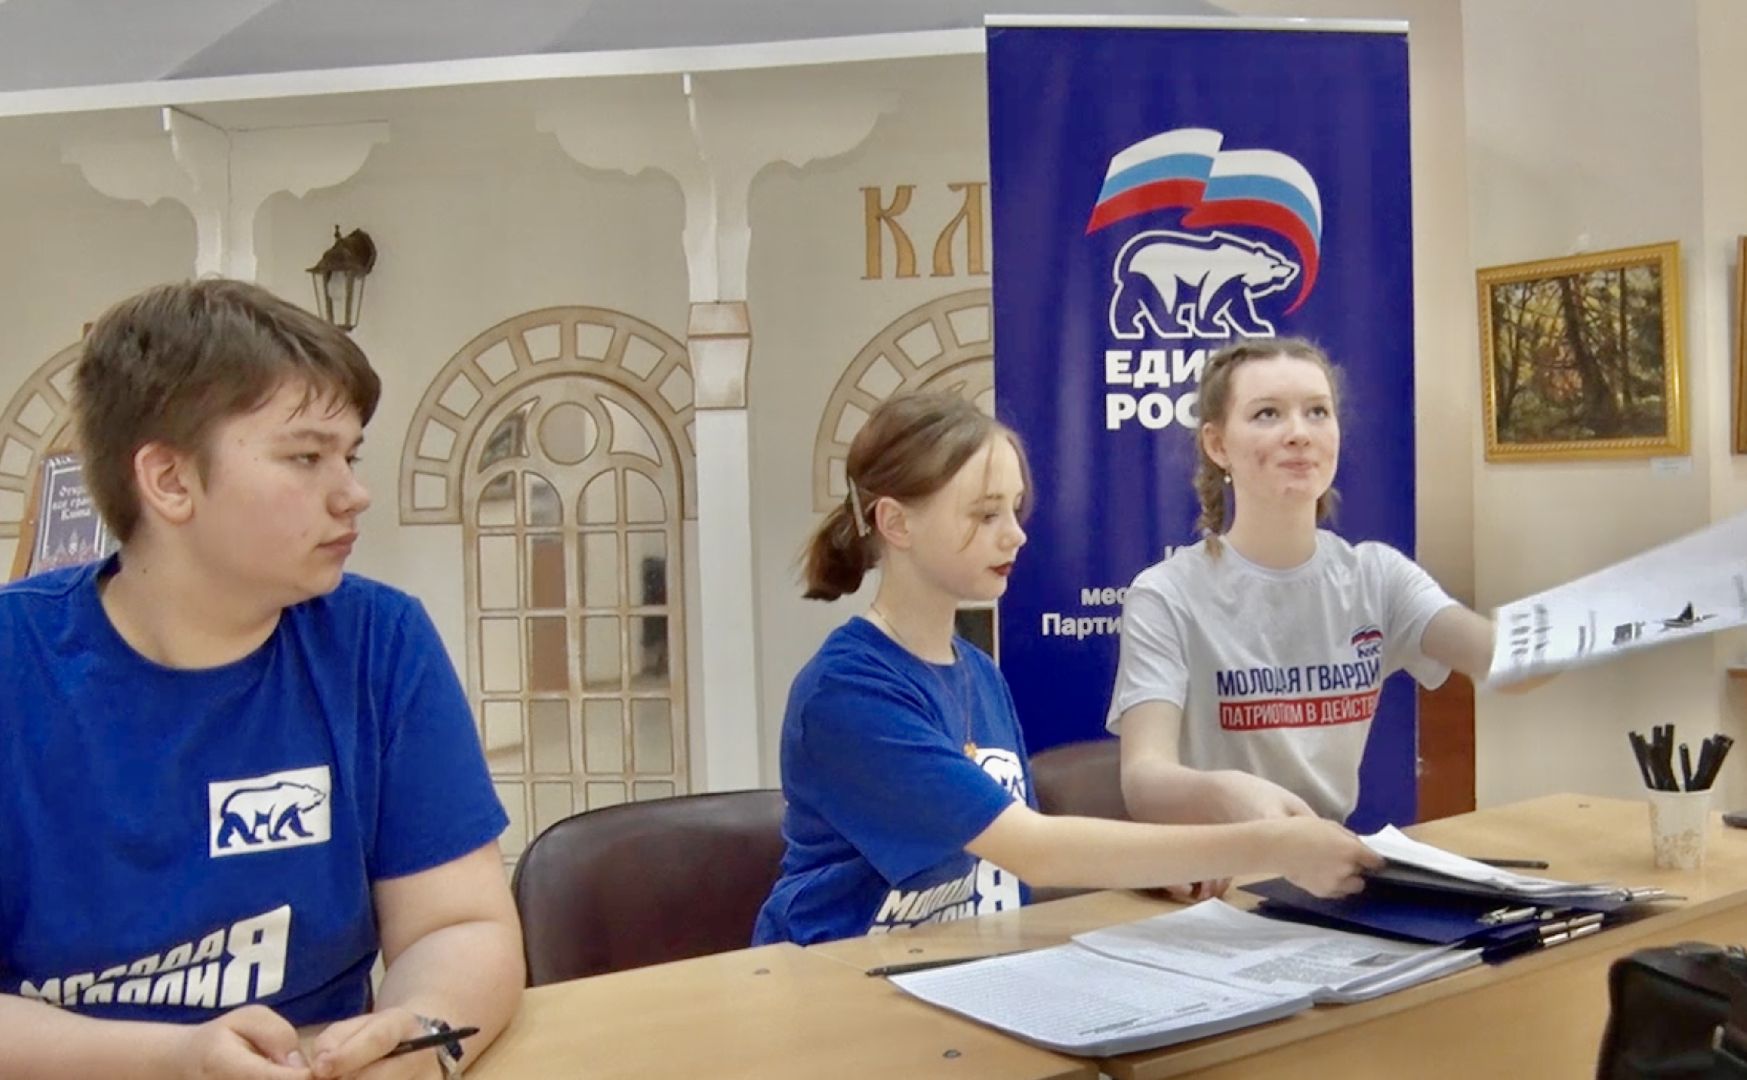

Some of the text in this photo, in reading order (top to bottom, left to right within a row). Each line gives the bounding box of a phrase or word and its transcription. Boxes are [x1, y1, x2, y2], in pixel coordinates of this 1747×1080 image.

[859, 181, 990, 279] КЛ
[1105, 349, 1222, 389] ЕДИ
[1305, 701, 1318, 723] В
